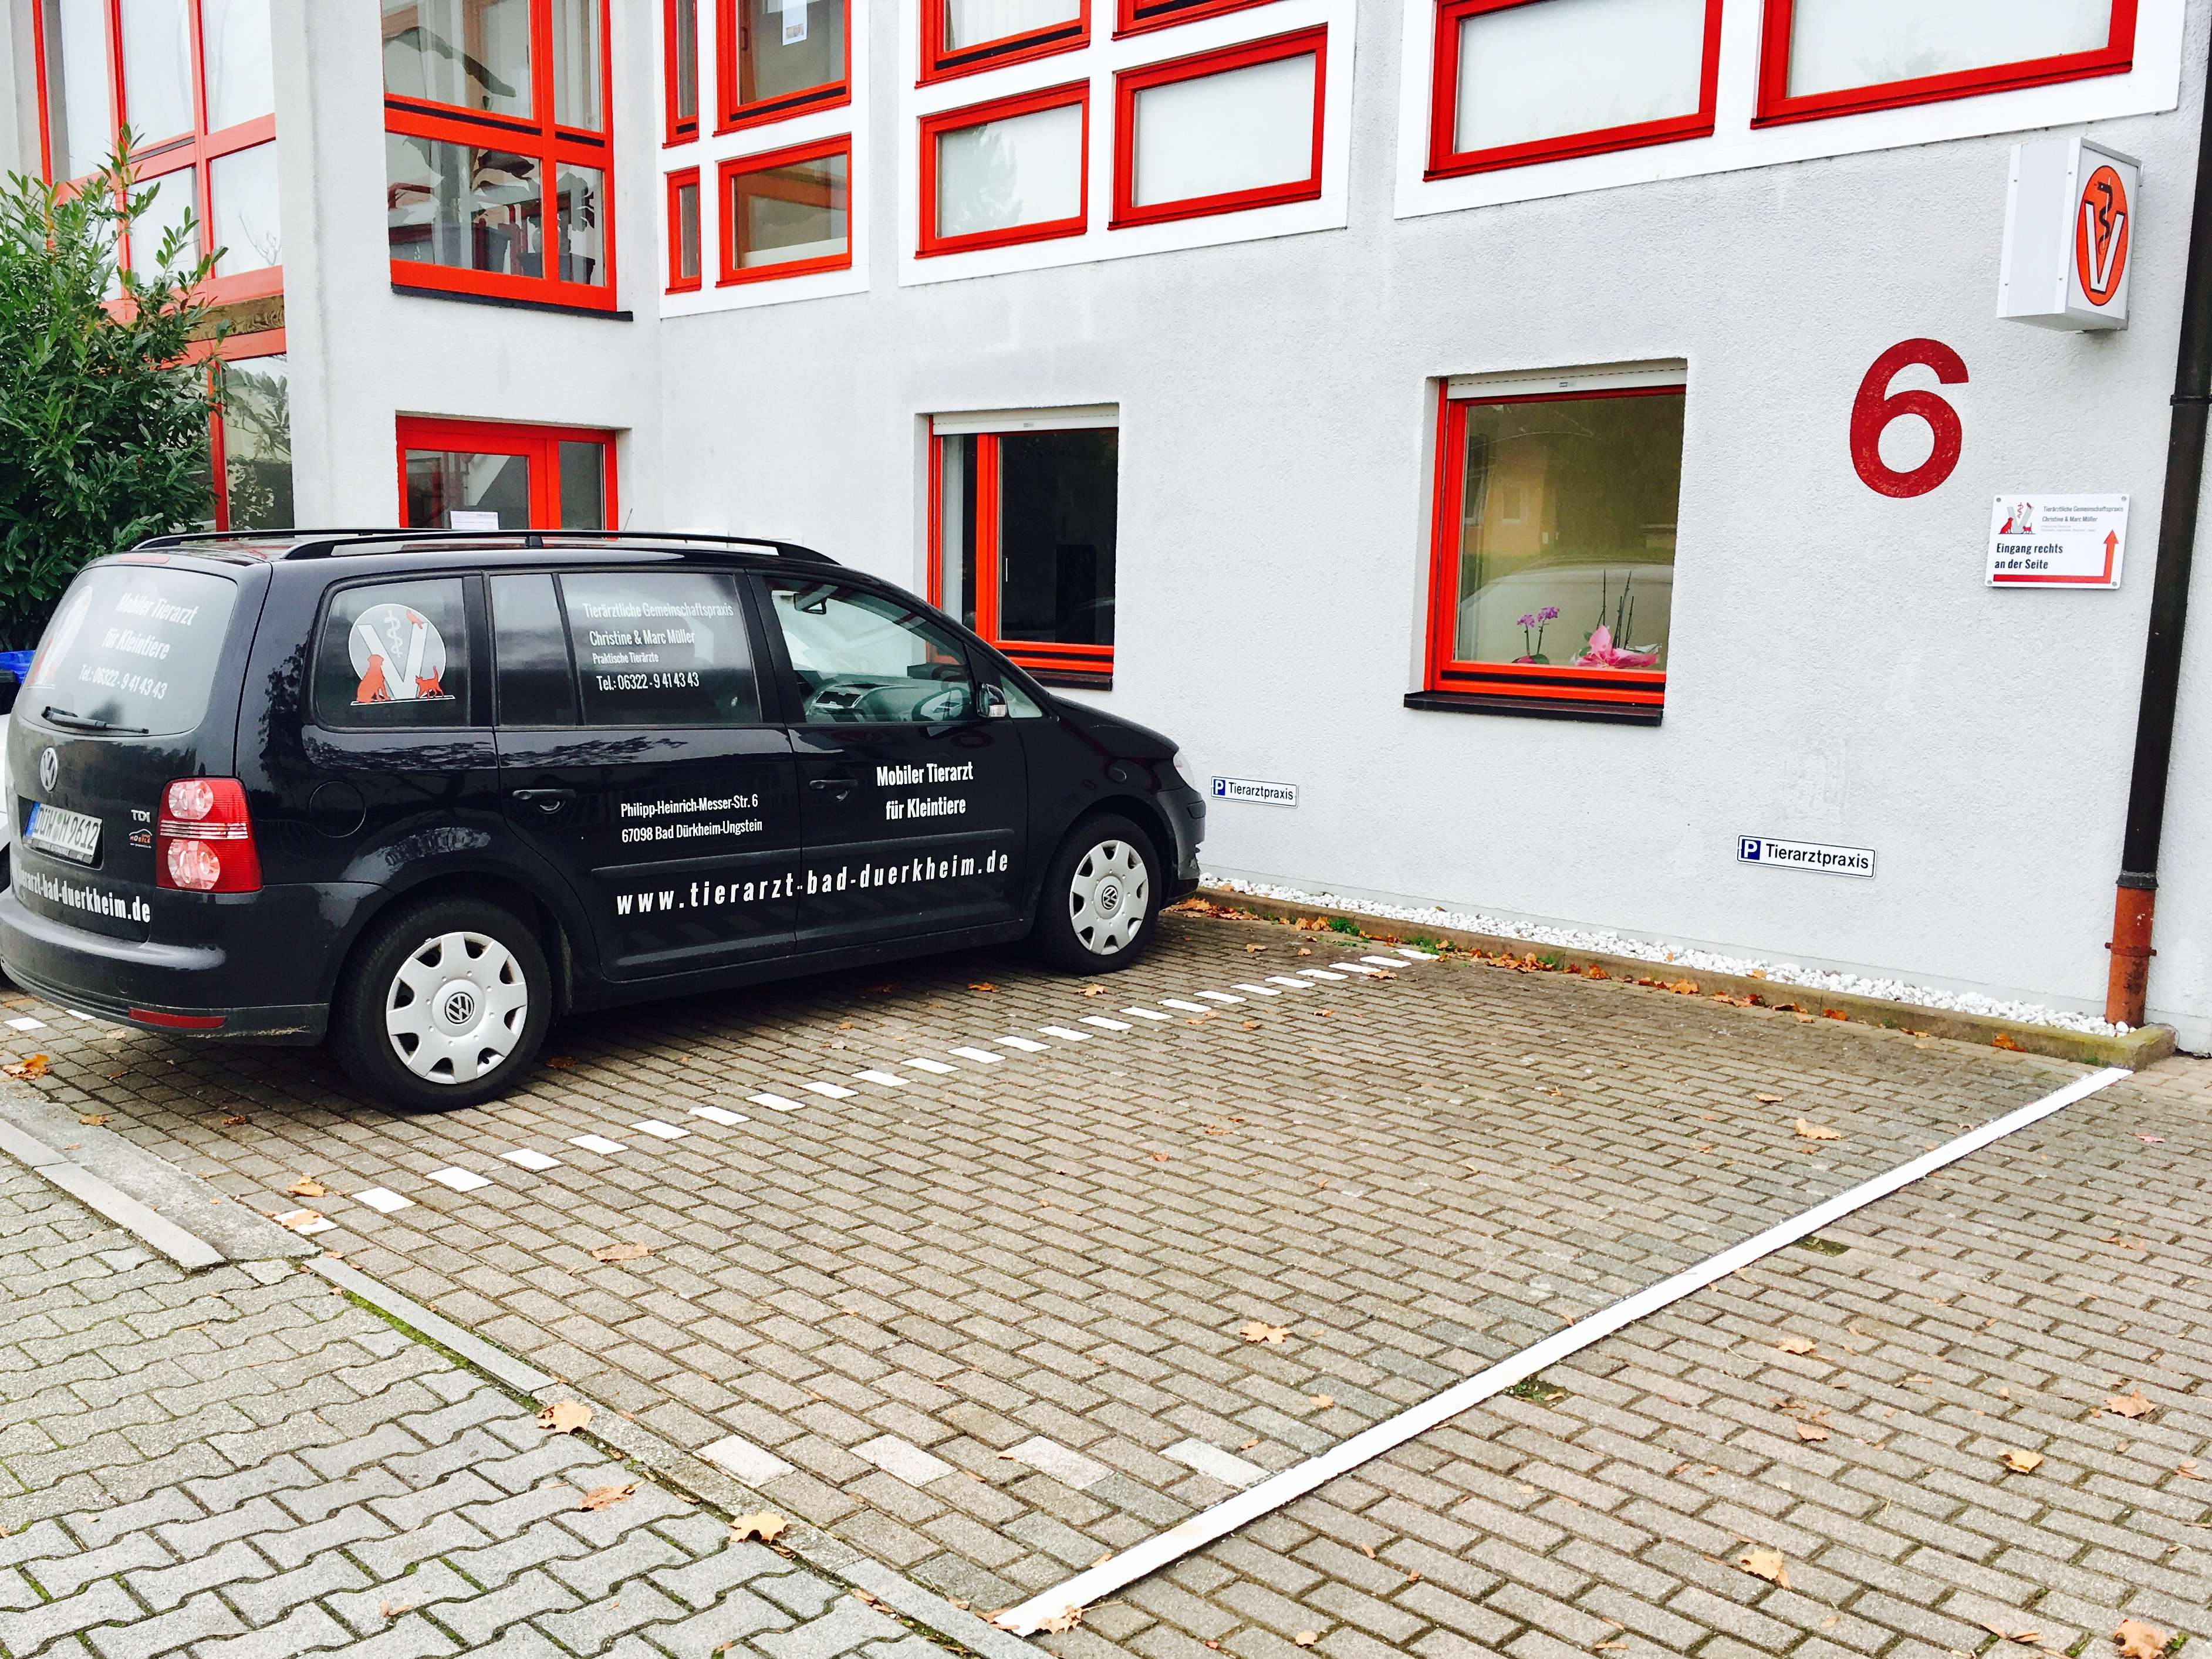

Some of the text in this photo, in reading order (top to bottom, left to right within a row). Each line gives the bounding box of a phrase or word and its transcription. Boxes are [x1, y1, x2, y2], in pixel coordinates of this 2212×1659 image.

[2084, 200, 2126, 295] V
[1850, 337, 1969, 498] 6
[1996, 543, 2064, 555] Eingang rechts
[1994, 559, 2048, 569] an der Seite
[115, 593, 199, 626] Mobiler Tierarzt
[583, 602, 734, 619] Tierärztliche Gemeinschaftspraxis
[102, 627, 170, 660] für Kleintiere
[589, 629, 695, 646] Christine & Marc Müller
[592, 651, 659, 664] Praktische Tierärzte
[93, 667, 120, 687] 06322
[139, 677, 153, 696] 43
[153, 681, 167, 700] 43
[596, 675, 616, 691] Tel.:
[617, 674, 648, 690] 06322
[662, 673, 672, 688] 41
[674, 673, 686, 687] 43
[687, 672, 700, 687] 43
[876, 761, 974, 786] Mobiler Tierarzt
[1215, 780, 1294, 800] P Tierarztpraxis
[131, 810, 150, 822] TDI
[621, 793, 758, 818] Philipp-Heinrich-Messer-Str. 6
[886, 796, 966, 820] für Kleintiere
[622, 819, 762, 843] 67098 Bad Dürkheim-Ungstein
[1744, 840, 1869, 869] P Tierarztpraxis
[616, 850, 1008, 915] www.tierarzt-bad-duerkheim.de
